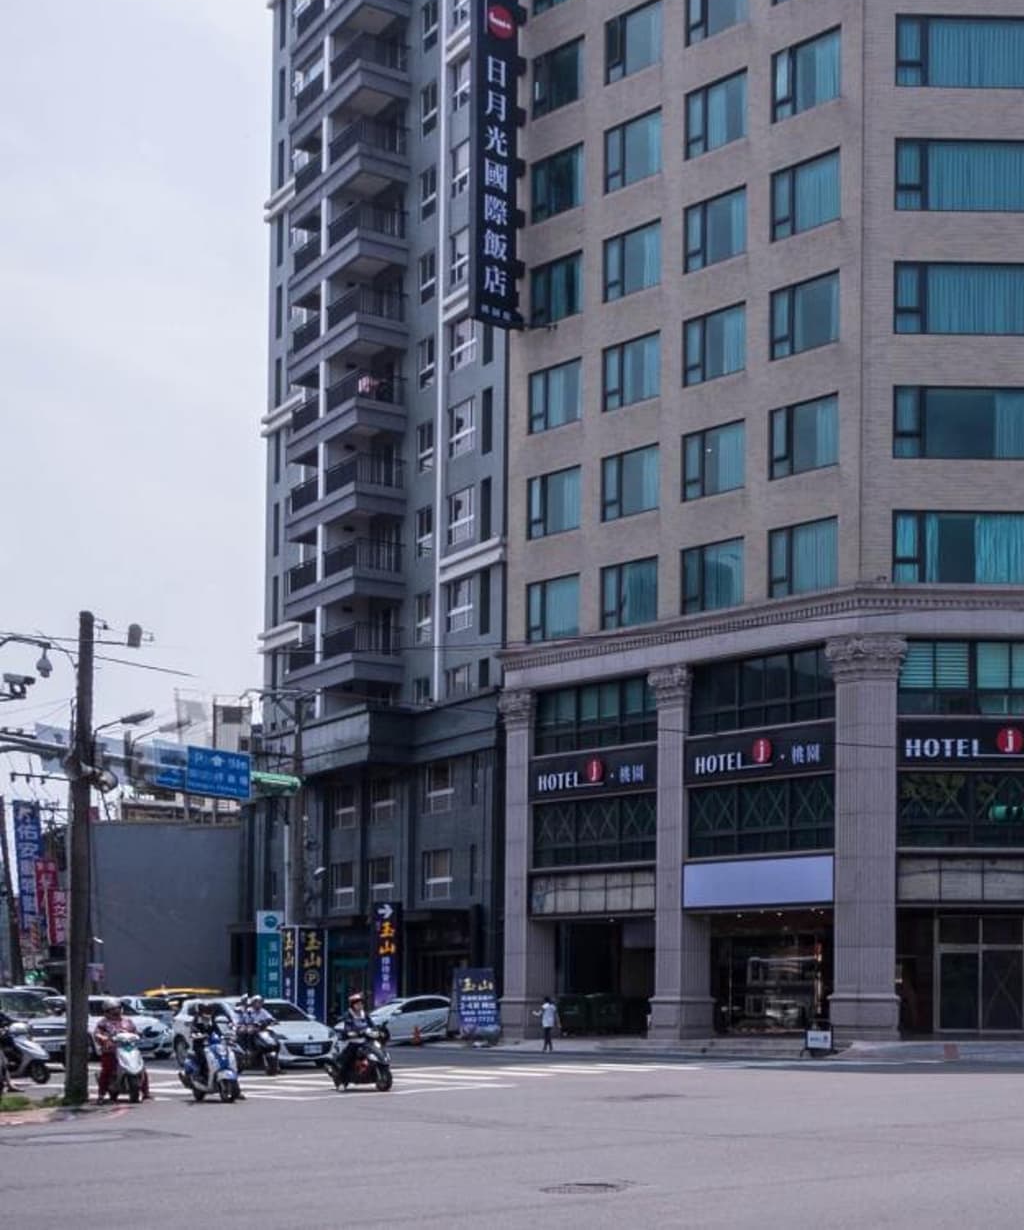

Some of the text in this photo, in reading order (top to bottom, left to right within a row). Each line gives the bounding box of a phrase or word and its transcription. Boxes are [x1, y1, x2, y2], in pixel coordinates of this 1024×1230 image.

[484, 55, 508, 298] 日月光國際飯店
[905, 738, 979, 758] HOTEL
[695, 752, 742, 774] HOTEL
[538, 771, 579, 792] HOTEL
